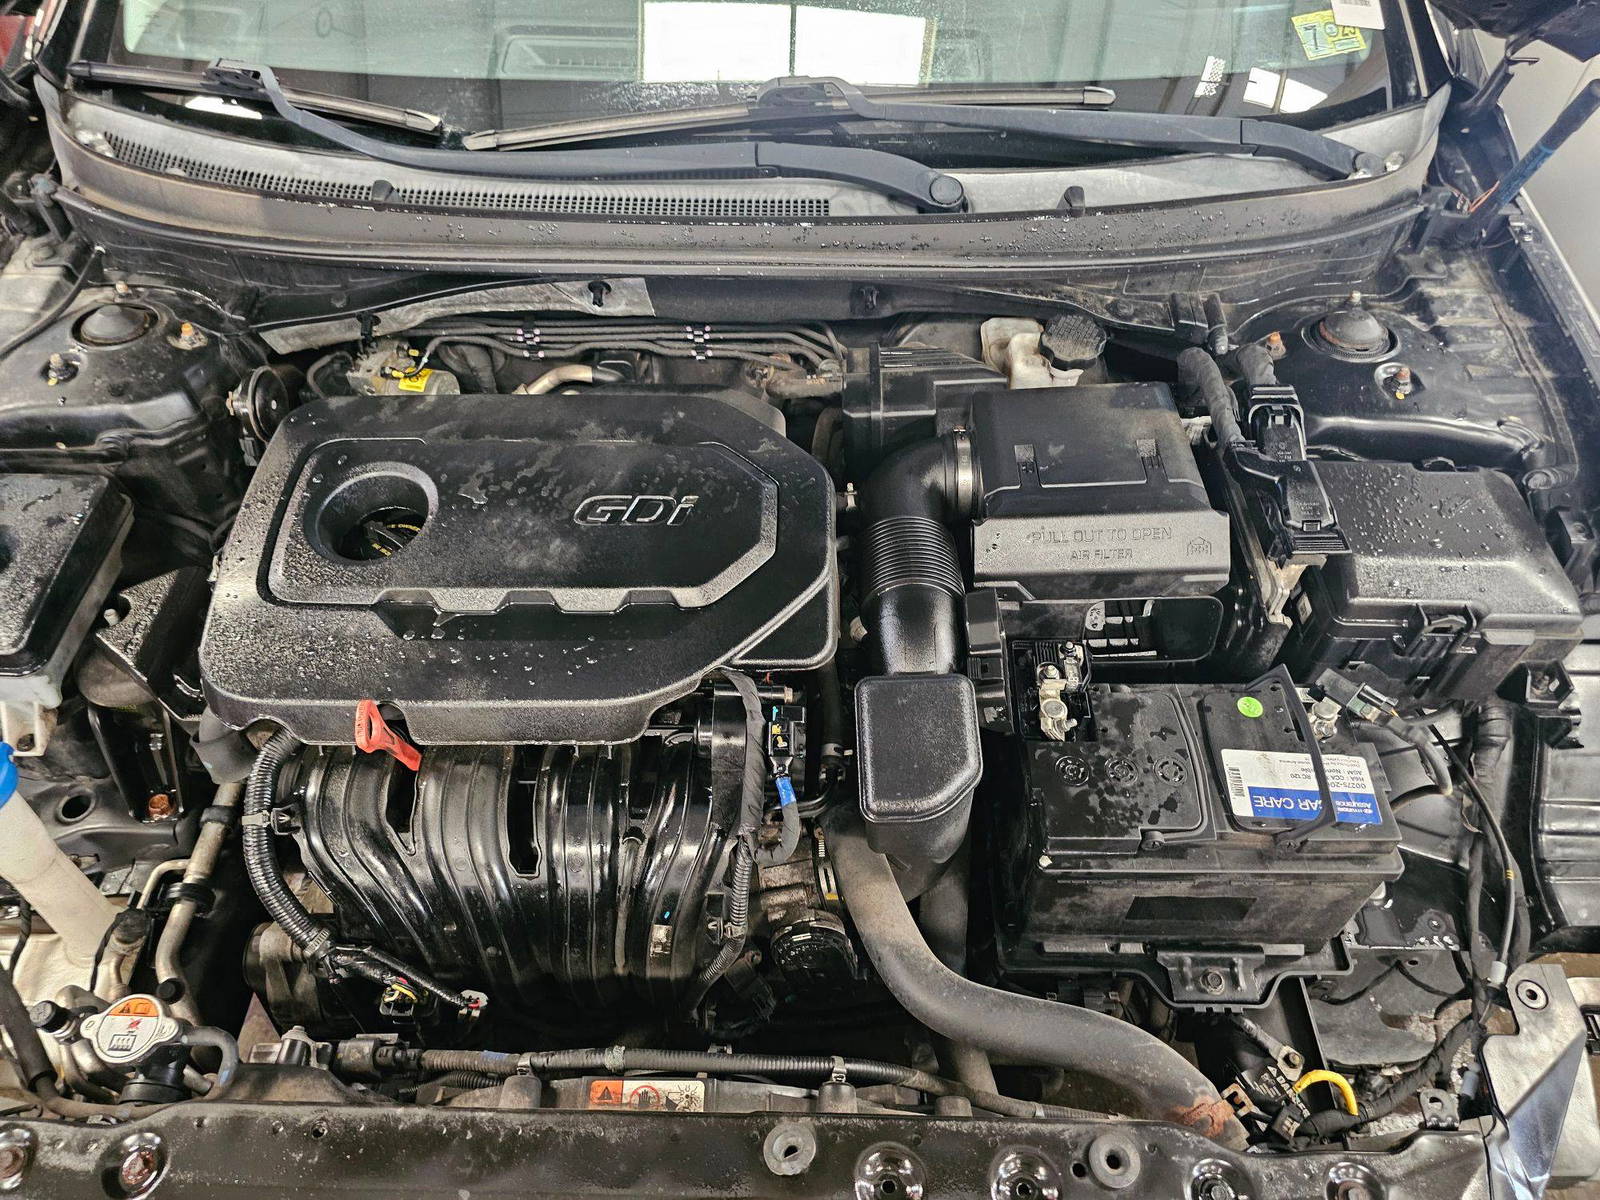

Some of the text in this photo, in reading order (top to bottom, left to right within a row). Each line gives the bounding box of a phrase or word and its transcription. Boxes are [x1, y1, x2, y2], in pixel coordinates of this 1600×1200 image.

[1031, 526, 1172, 544] PULL OUT TO OPEN
[1070, 548, 1133, 561] AIR FILTER
[1328, 781, 1366, 789] 00275-20
[1253, 795, 1294, 809] CARE
[1335, 800, 1371, 808] Assurance
